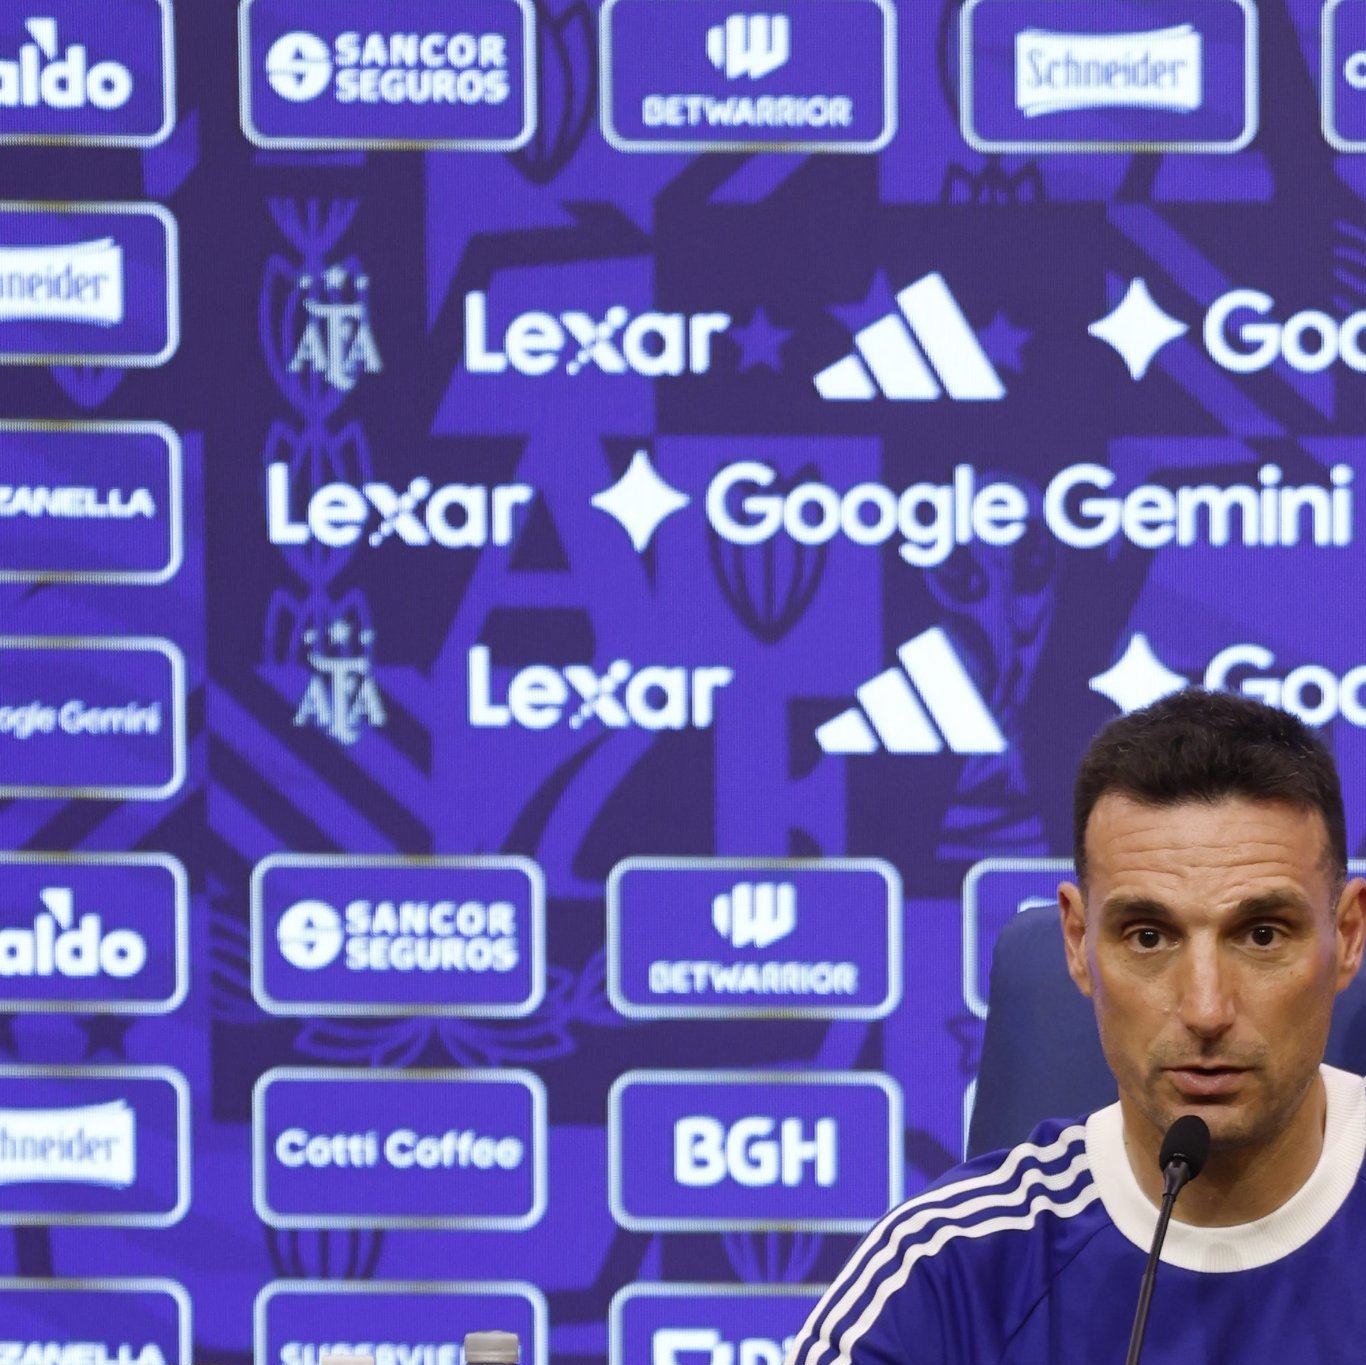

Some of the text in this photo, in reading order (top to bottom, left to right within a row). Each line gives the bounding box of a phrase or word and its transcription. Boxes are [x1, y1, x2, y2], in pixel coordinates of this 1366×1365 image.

[332, 32, 507, 67] SANCOR
[1025, 47, 1187, 90] Schneider
[336, 68, 510, 104] SEGUROS
[642, 95, 852, 127] BETWARRIOR
[0, 264, 108, 300] neider
[466, 291, 730, 376] Lexar
[268, 463, 533, 547] Lexar
[706, 461, 1353, 567] Google Gemini
[469, 646, 733, 730] Lexar
[344, 900, 515, 935] SANCOR
[346, 936, 519, 971] SEGUROS
[649, 961, 858, 994] BETWARRIOR
[276, 1128, 523, 1169] Cotti Coffee
[674, 1116, 837, 1187] BGH
